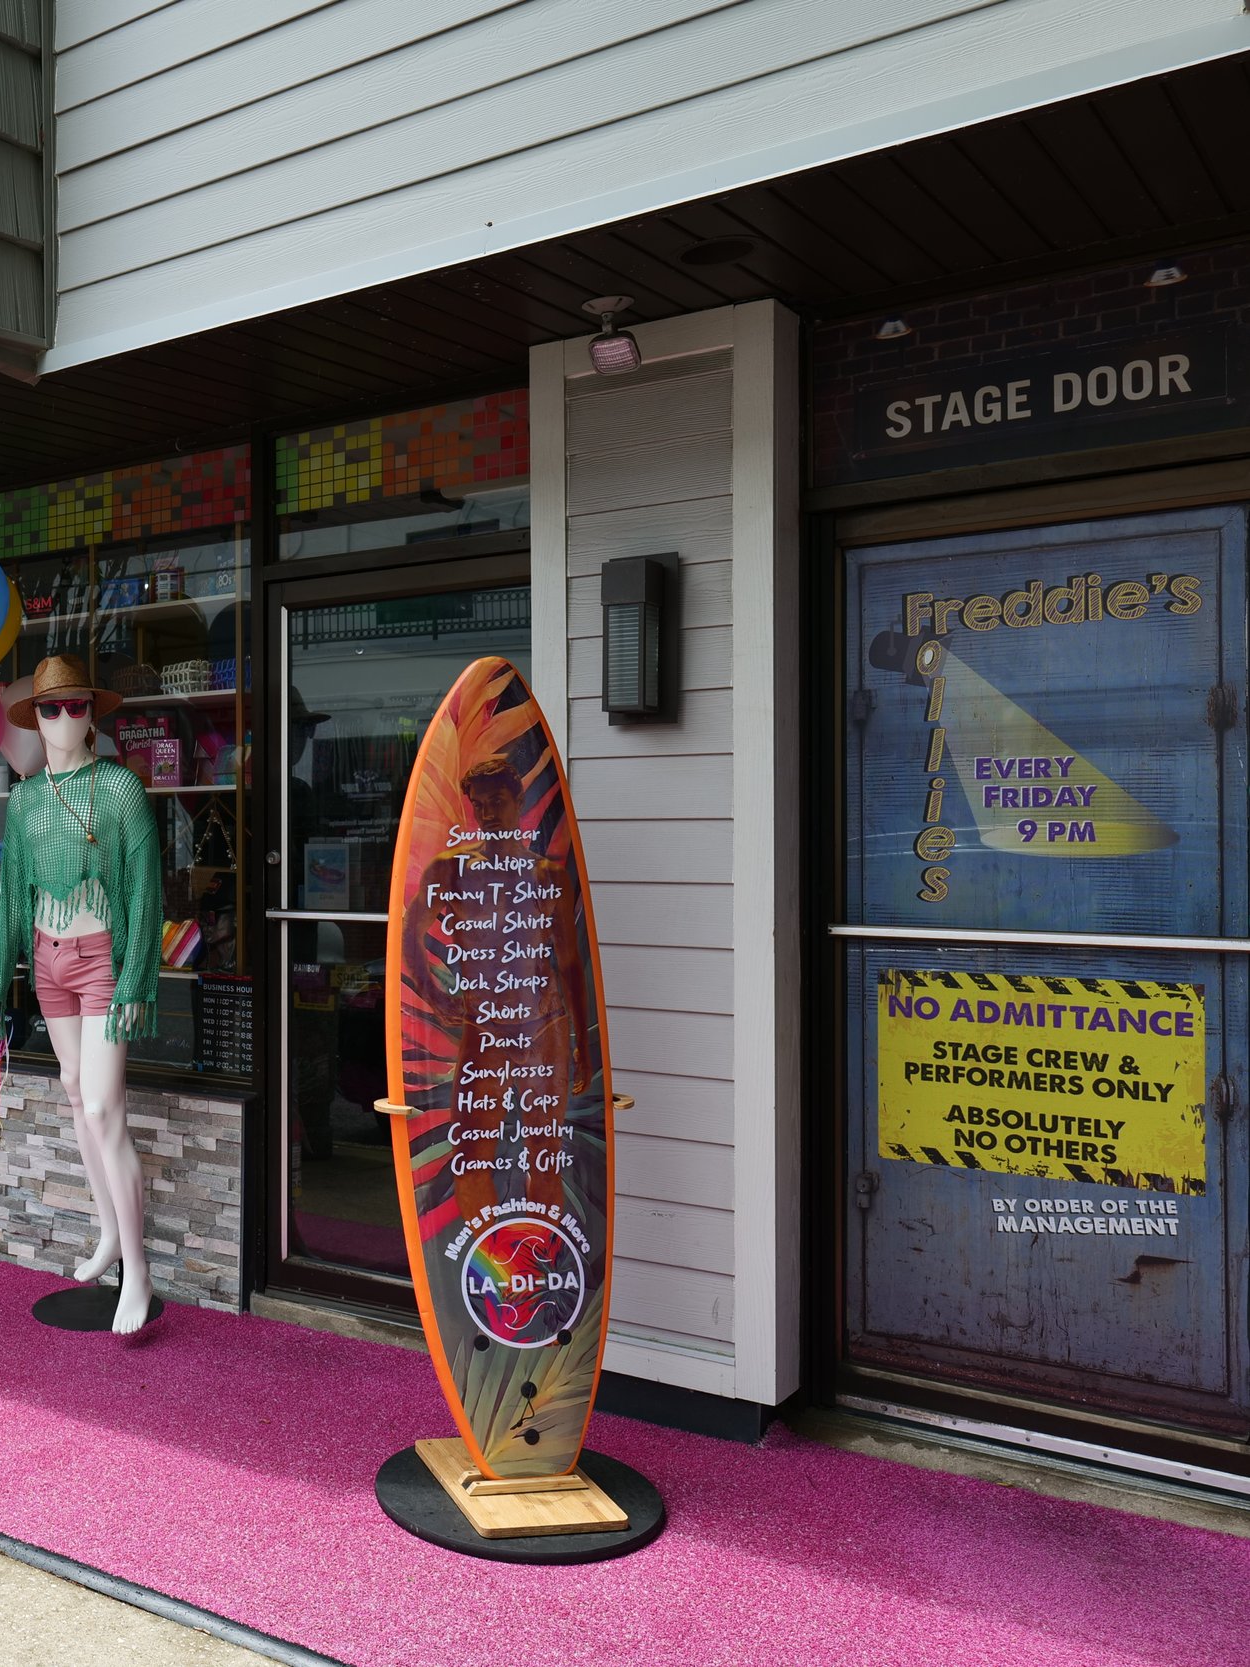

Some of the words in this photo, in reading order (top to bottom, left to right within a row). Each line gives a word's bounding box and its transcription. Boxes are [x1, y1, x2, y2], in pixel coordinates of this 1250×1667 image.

[885, 378, 1032, 439] STAGE
[1052, 353, 1193, 413] DOOR
[904, 573, 1202, 637] Freddie's
[119, 727, 165, 741] DRAGATHA
[126, 738, 152, 752] Christ
[974, 755, 1075, 780] EVERY
[982, 785, 1097, 808] FRIDAY
[446, 824, 541, 848] Swimwear
[1016, 818, 1038, 843] 9
[1046, 820, 1097, 843] PM
[453, 853, 535, 878] Tanktops
[426, 883, 485, 908] Funny
[488, 881, 563, 906] T-Shirts
[440, 912, 497, 936] Casual
[502, 911, 554, 934] Shirts
[445, 943, 497, 965] Dress
[501, 940, 553, 964] Shirts
[203, 983, 235, 992] BUSINESS
[236, 985, 253, 993] HOU
[448, 971, 491, 995] Jock
[494, 970, 549, 994] Straps
[476, 1001, 532, 1024] Shorts
[888, 994, 941, 1021] NO
[950, 998, 1195, 1037] ADMITTANCE
[478, 1031, 533, 1053] Pants
[932, 1041, 1018, 1065] STAGE
[1026, 1047, 1109, 1072] CREW
[1118, 1055, 1141, 1075] &
[460, 1060, 555, 1086] Sunglasses
[904, 1062, 1084, 1096] PERFORMERS
[1092, 1077, 1175, 1103] ONLY
[457, 1090, 498, 1113] Hats
[502, 1087, 515, 1113] &
[519, 1088, 561, 1114] Caps
[447, 1121, 505, 1146] Casual
[509, 1119, 574, 1143] Jewelry
[945, 1104, 1126, 1140] ABSOLUTELY
[954, 1128, 997, 1150] NO
[1004, 1133, 1118, 1165] OTHERS
[450, 1152, 514, 1176] Games
[517, 1147, 530, 1173] &
[535, 1148, 575, 1174] Gifts
[992, 1198, 1018, 1213] BY
[1024, 1199, 1094, 1214] ORDER
[1100, 1199, 1129, 1214] OF
[1135, 1199, 1179, 1215] THE
[444, 1216, 483, 1262] Men's
[479, 1197, 547, 1223] Fashion
[547, 1204, 561, 1221] &
[559, 1213, 591, 1254] More
[997, 1215, 1179, 1236] MANAGEMENT
[468, 1271, 579, 1295] LA-DI-DA
